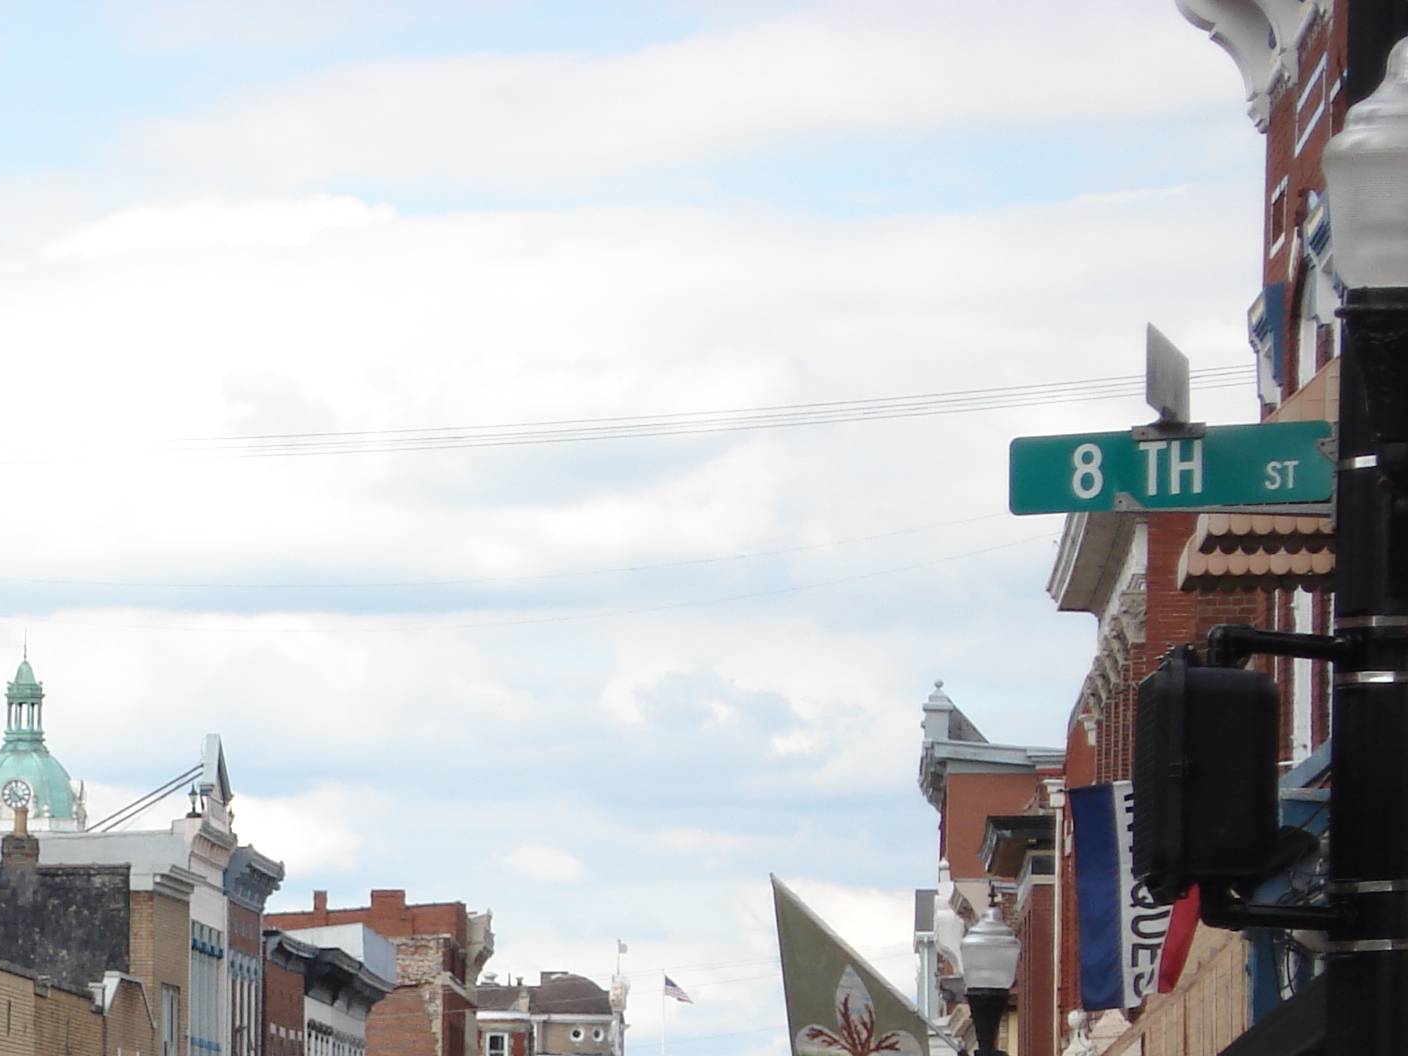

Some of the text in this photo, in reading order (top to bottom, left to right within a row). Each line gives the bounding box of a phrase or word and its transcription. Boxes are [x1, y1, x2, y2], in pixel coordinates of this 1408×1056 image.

[1072, 440, 1299, 499] 8 TH ST
